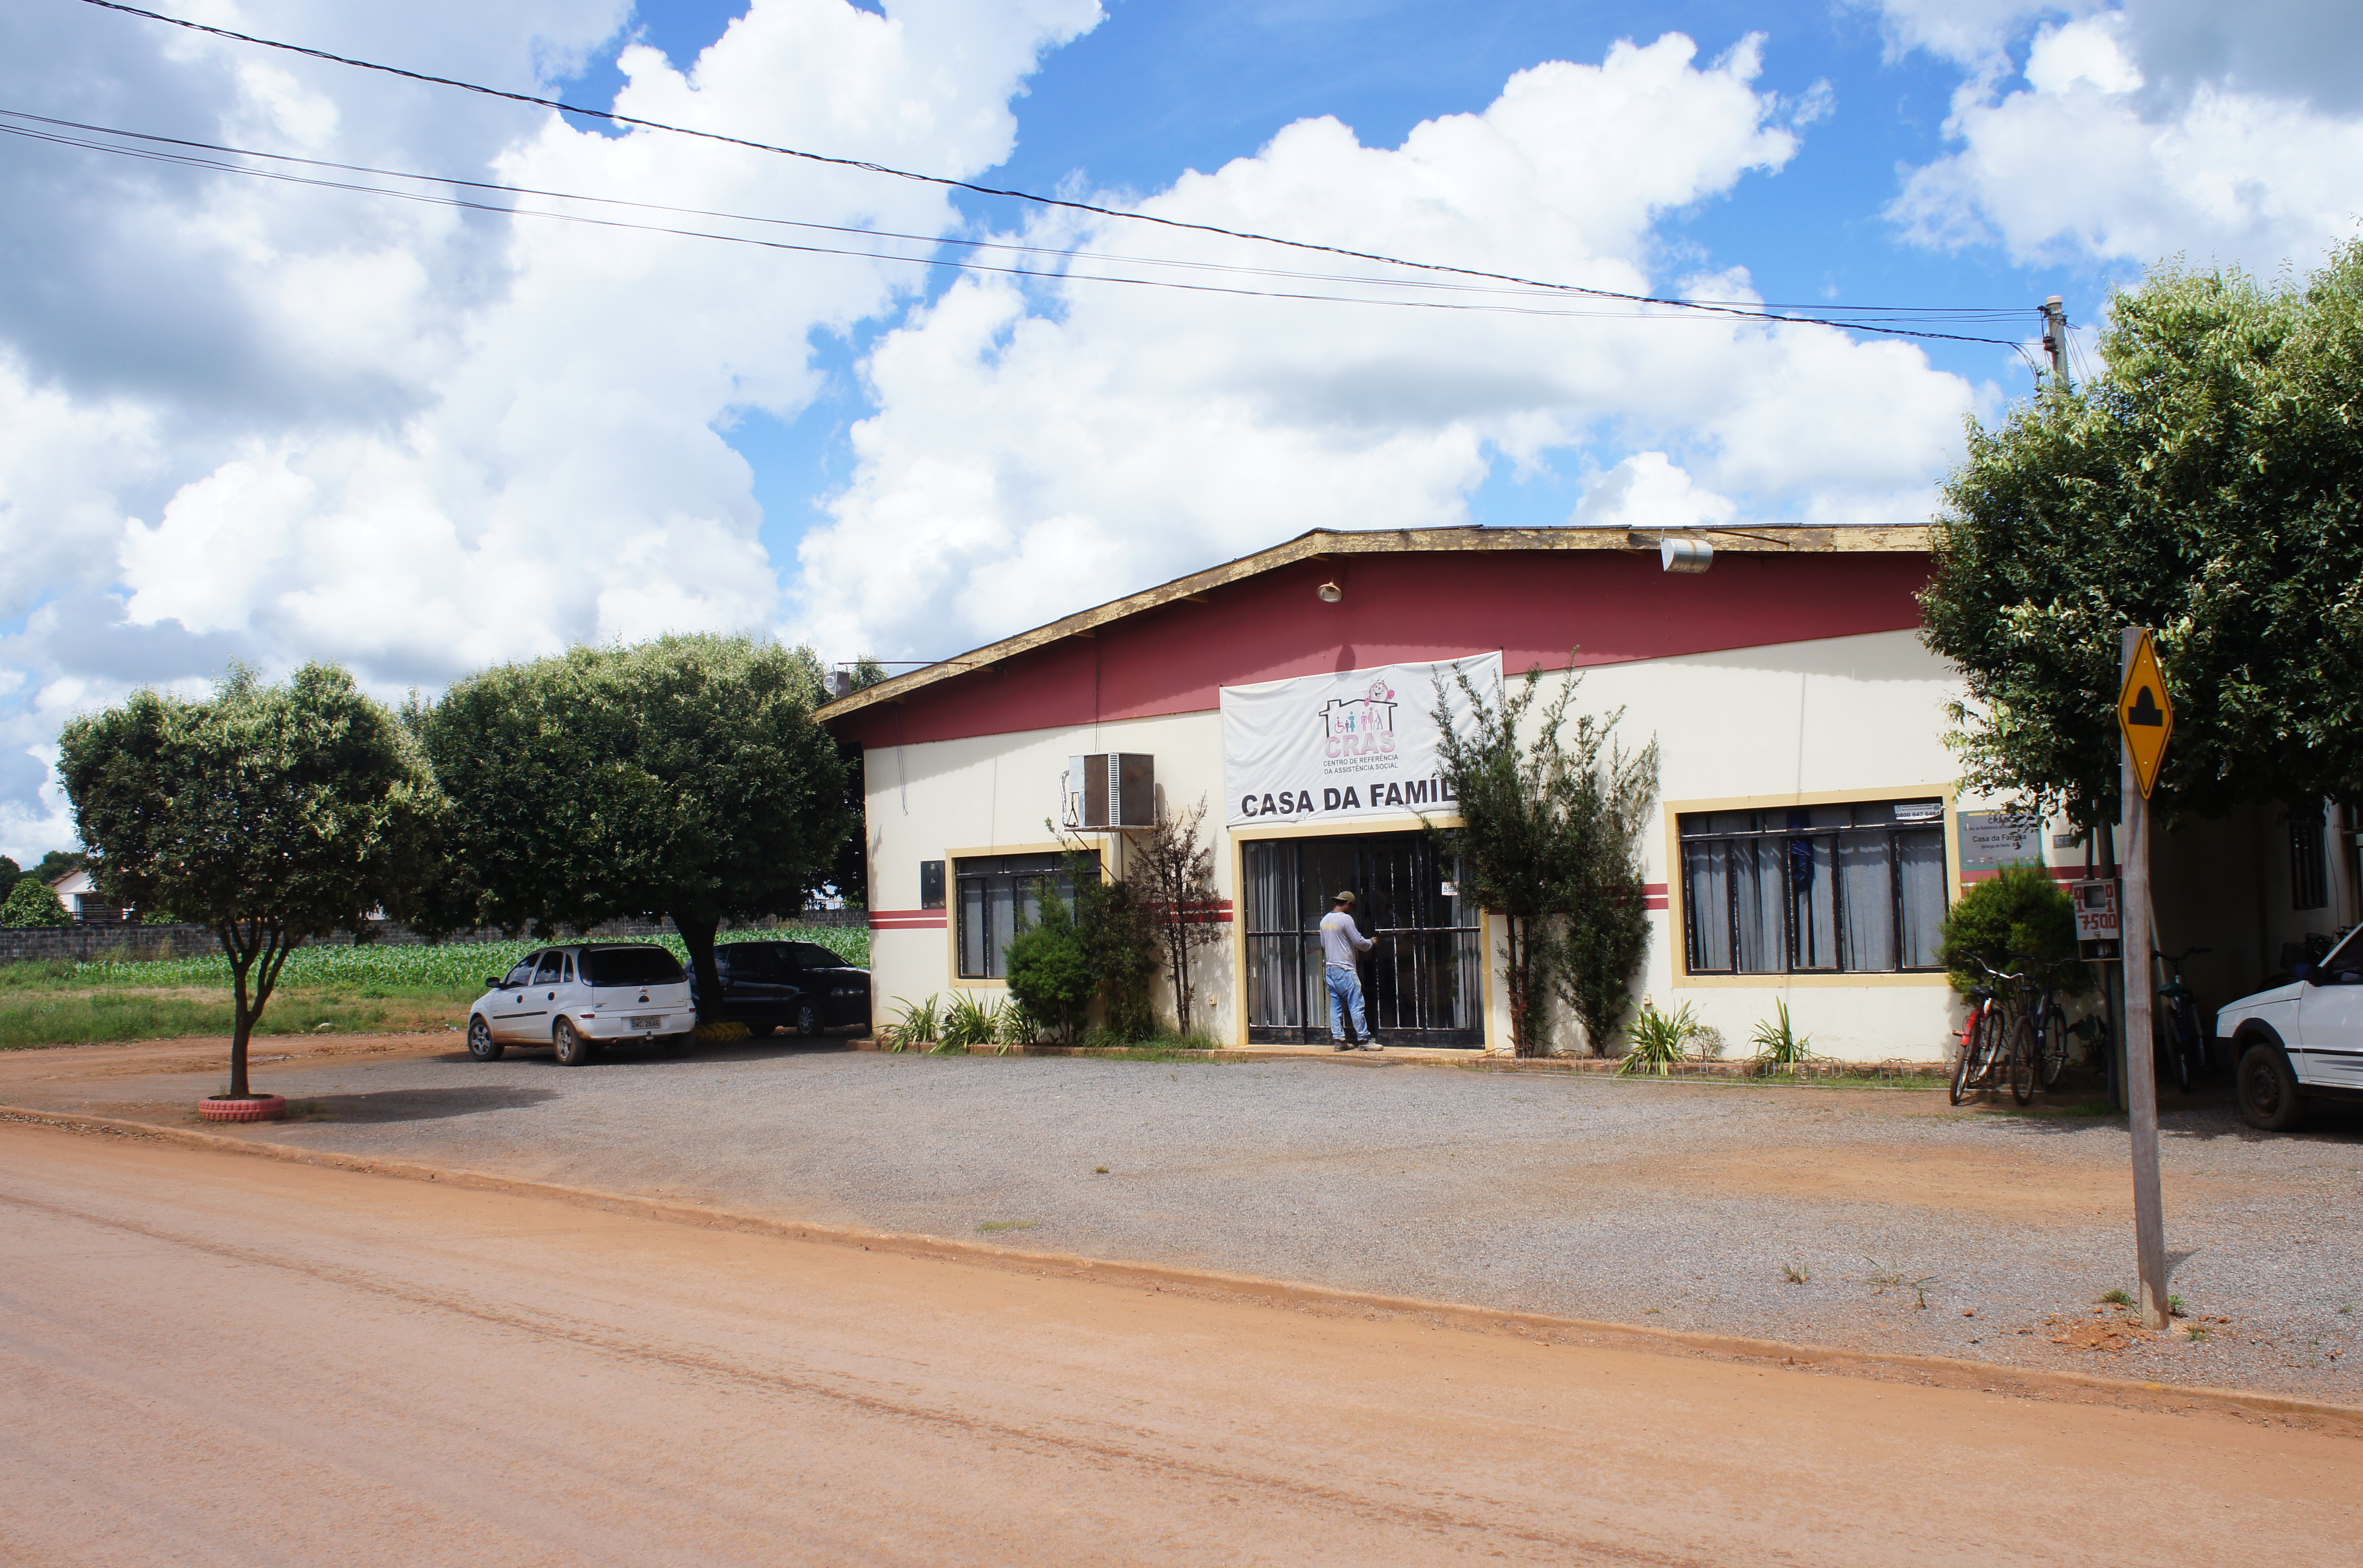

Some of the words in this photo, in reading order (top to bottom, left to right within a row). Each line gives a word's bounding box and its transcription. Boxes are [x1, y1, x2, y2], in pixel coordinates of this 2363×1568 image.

[1325, 731, 1396, 758] CRAS
[1334, 764, 1374, 773] ASSISTÊNCIA
[1375, 761, 1398, 770] SOCIAL
[1359, 754, 1399, 763] REFERÊNCIA
[1241, 789, 1315, 818] CASA
[1323, 785, 1361, 811] DA
[1370, 772, 1458, 808] FAMÍL
[2078, 912, 2118, 930] 7500
